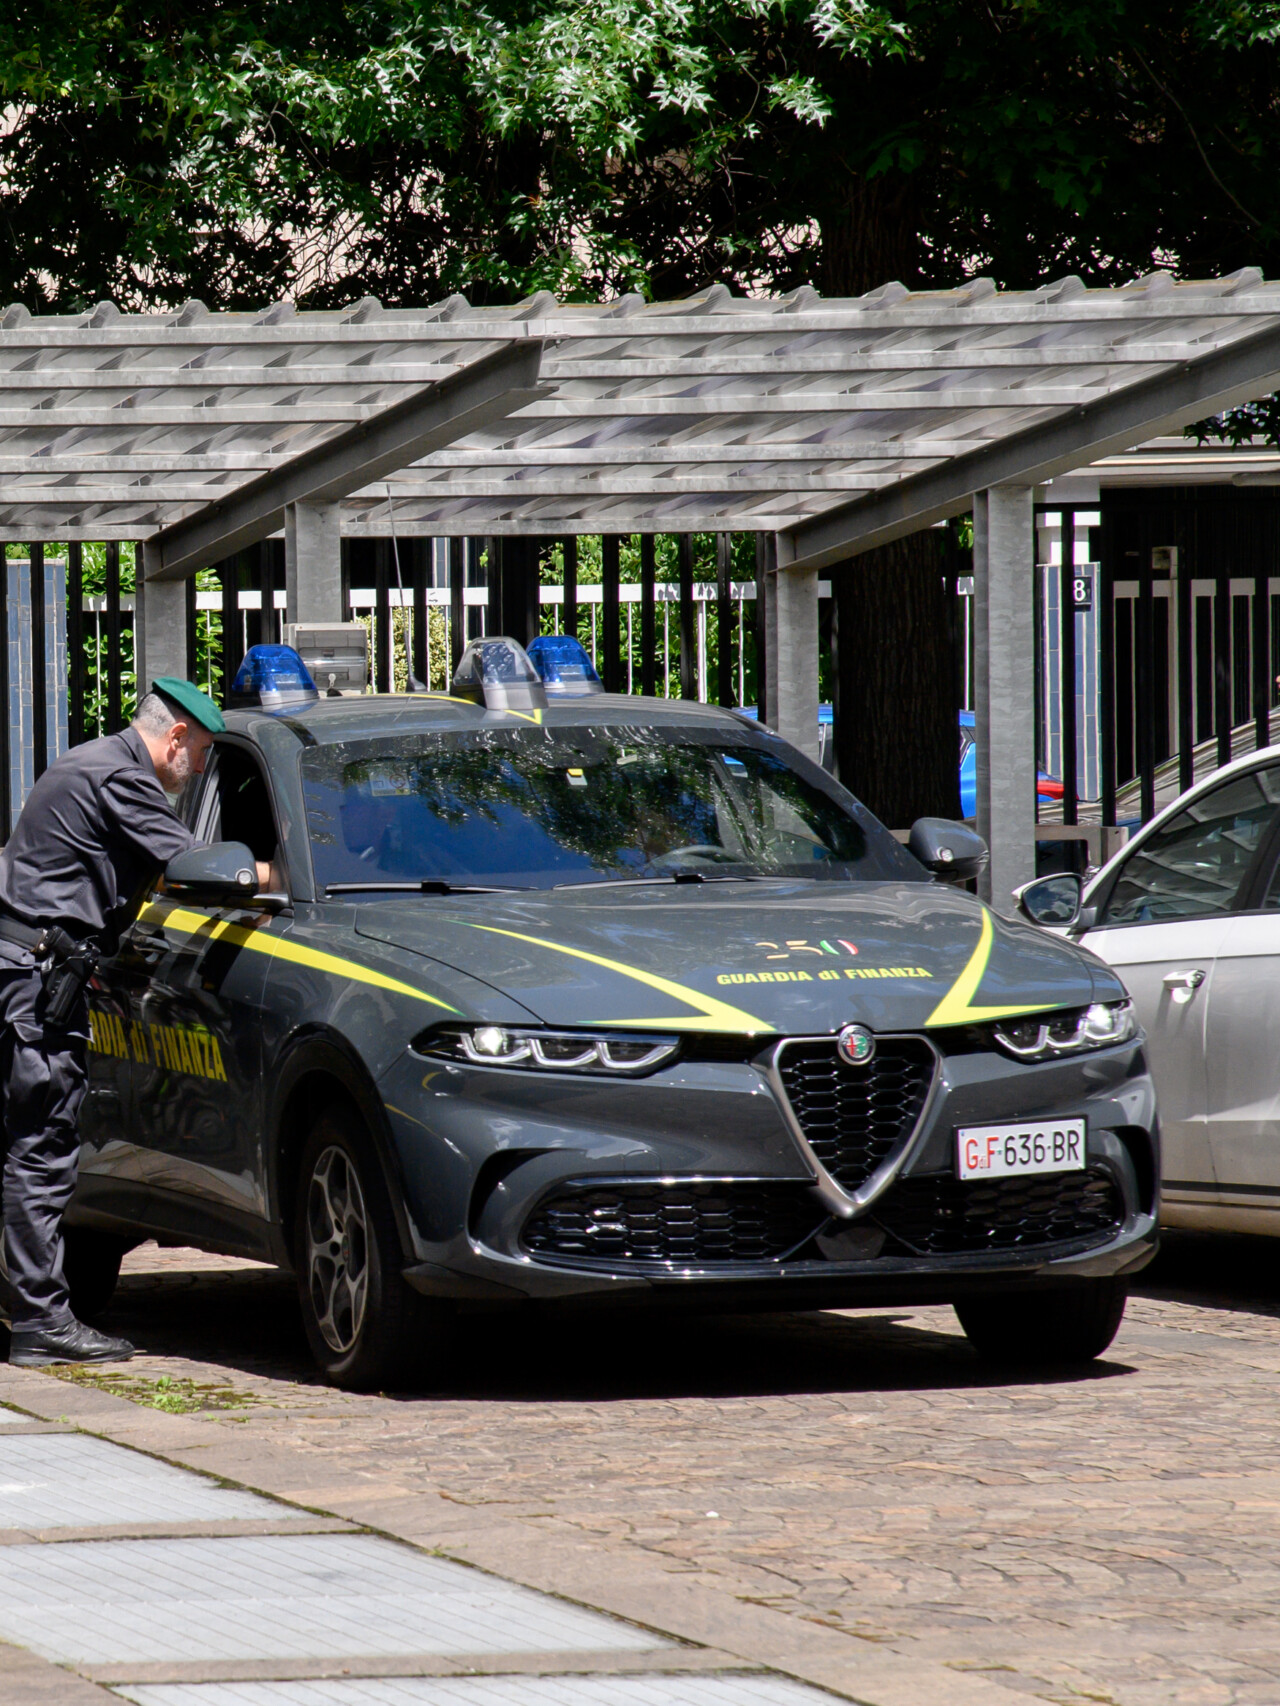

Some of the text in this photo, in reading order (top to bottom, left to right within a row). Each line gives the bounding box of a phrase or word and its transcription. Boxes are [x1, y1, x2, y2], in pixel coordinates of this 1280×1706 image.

[716, 967, 934, 985] GUARDIA di FINANZA
[87, 1008, 228, 1082] RDIA di FINANZA
